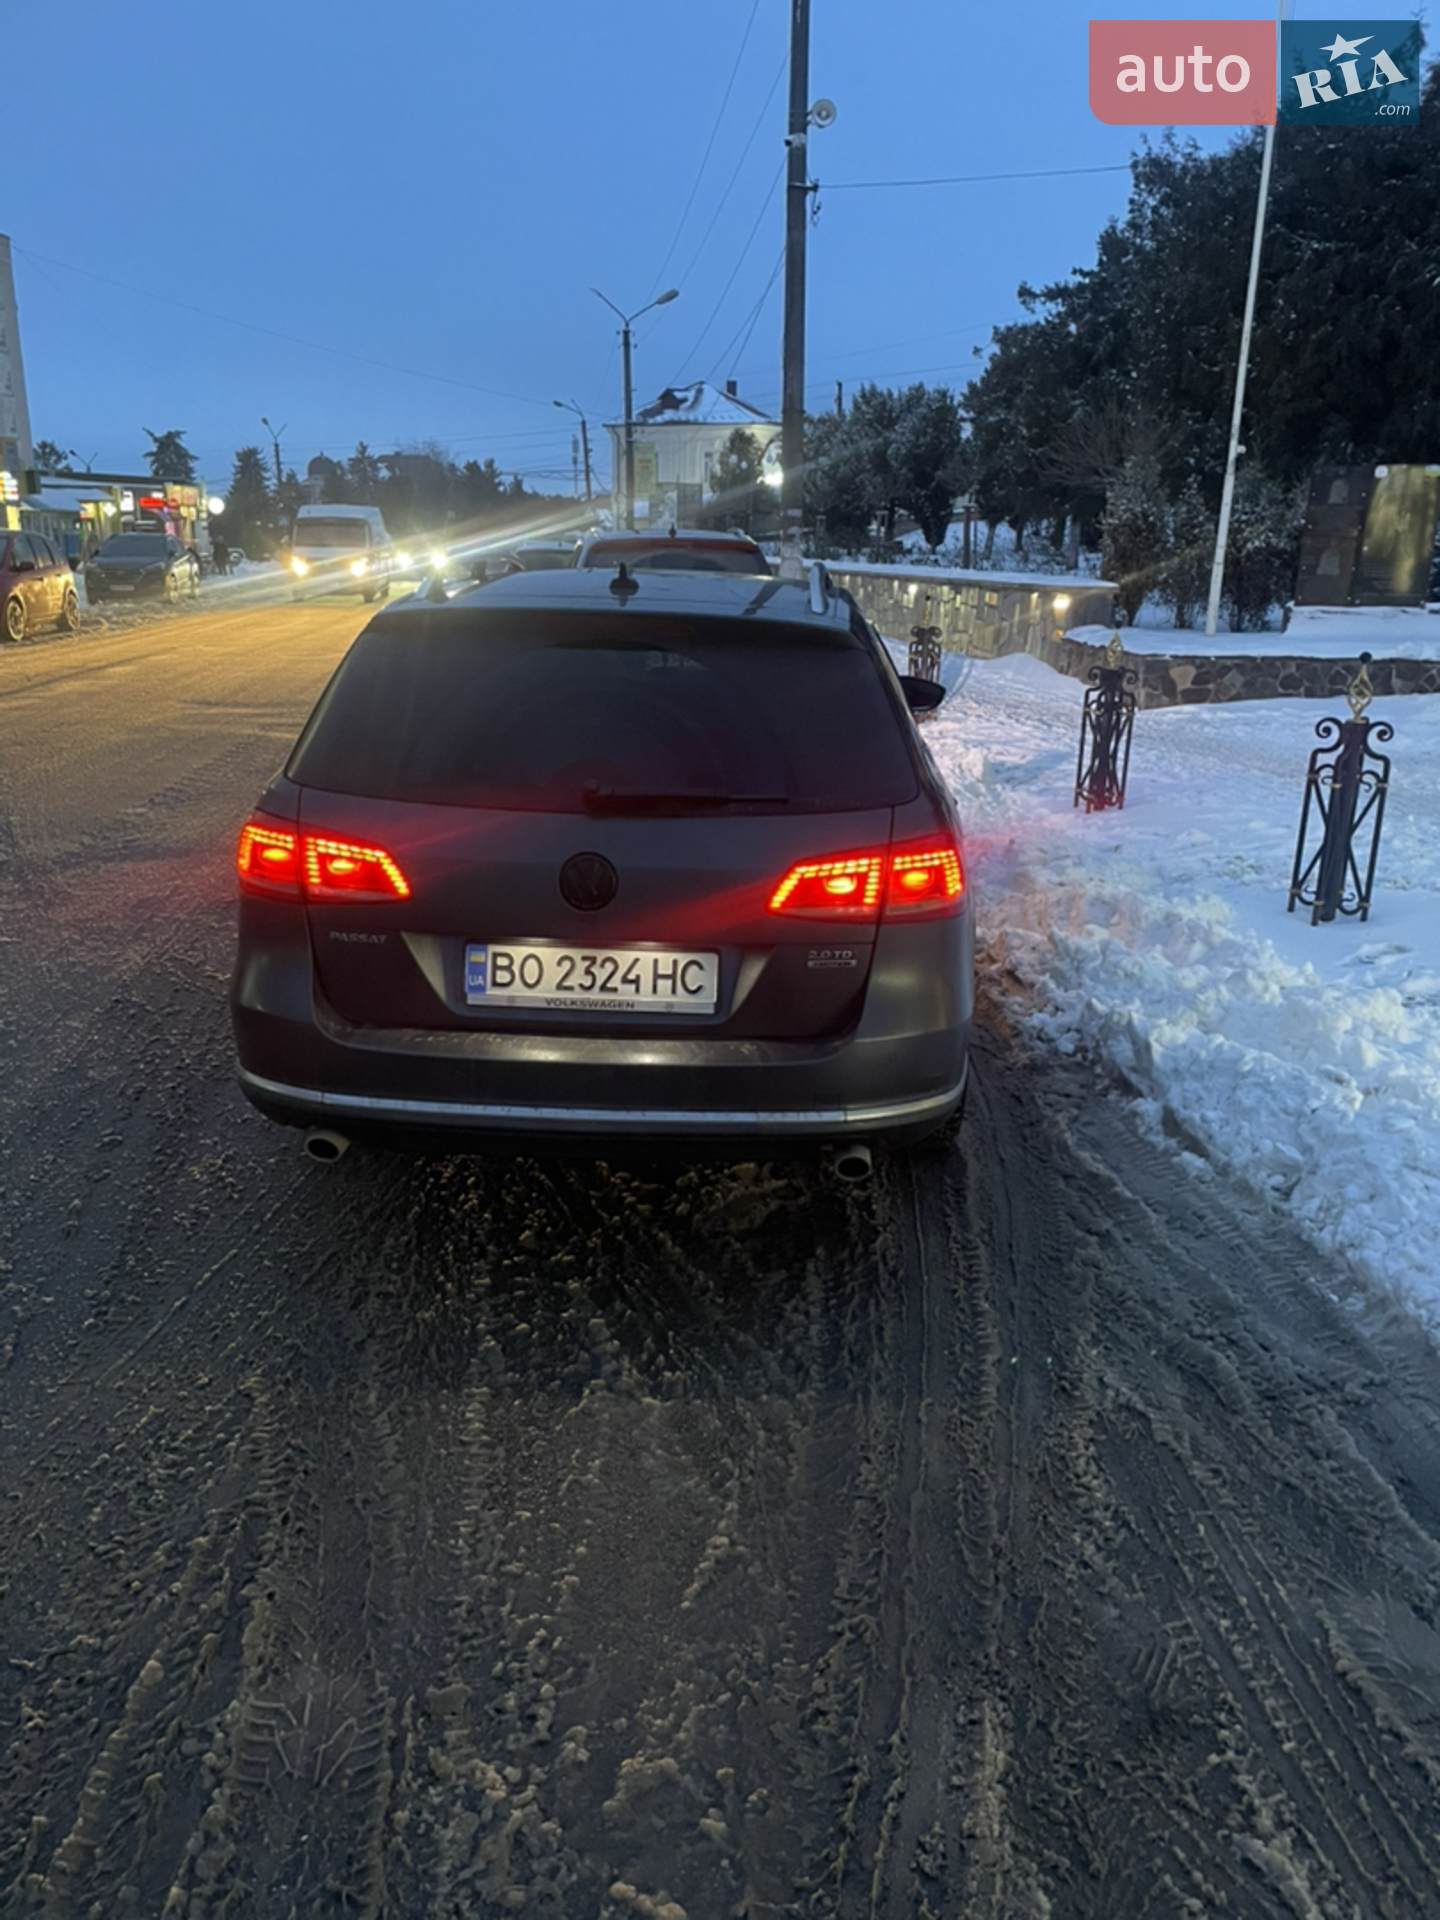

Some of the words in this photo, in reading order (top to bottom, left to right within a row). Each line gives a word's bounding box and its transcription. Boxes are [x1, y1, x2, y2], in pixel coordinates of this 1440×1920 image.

[329, 930, 388, 945] PASSAT
[490, 951, 545, 990] BO
[555, 954, 641, 994] 2324
[652, 957, 705, 995] HC
[468, 974, 484, 986] UA
[545, 998, 635, 1009] VOLKSWAGEN
